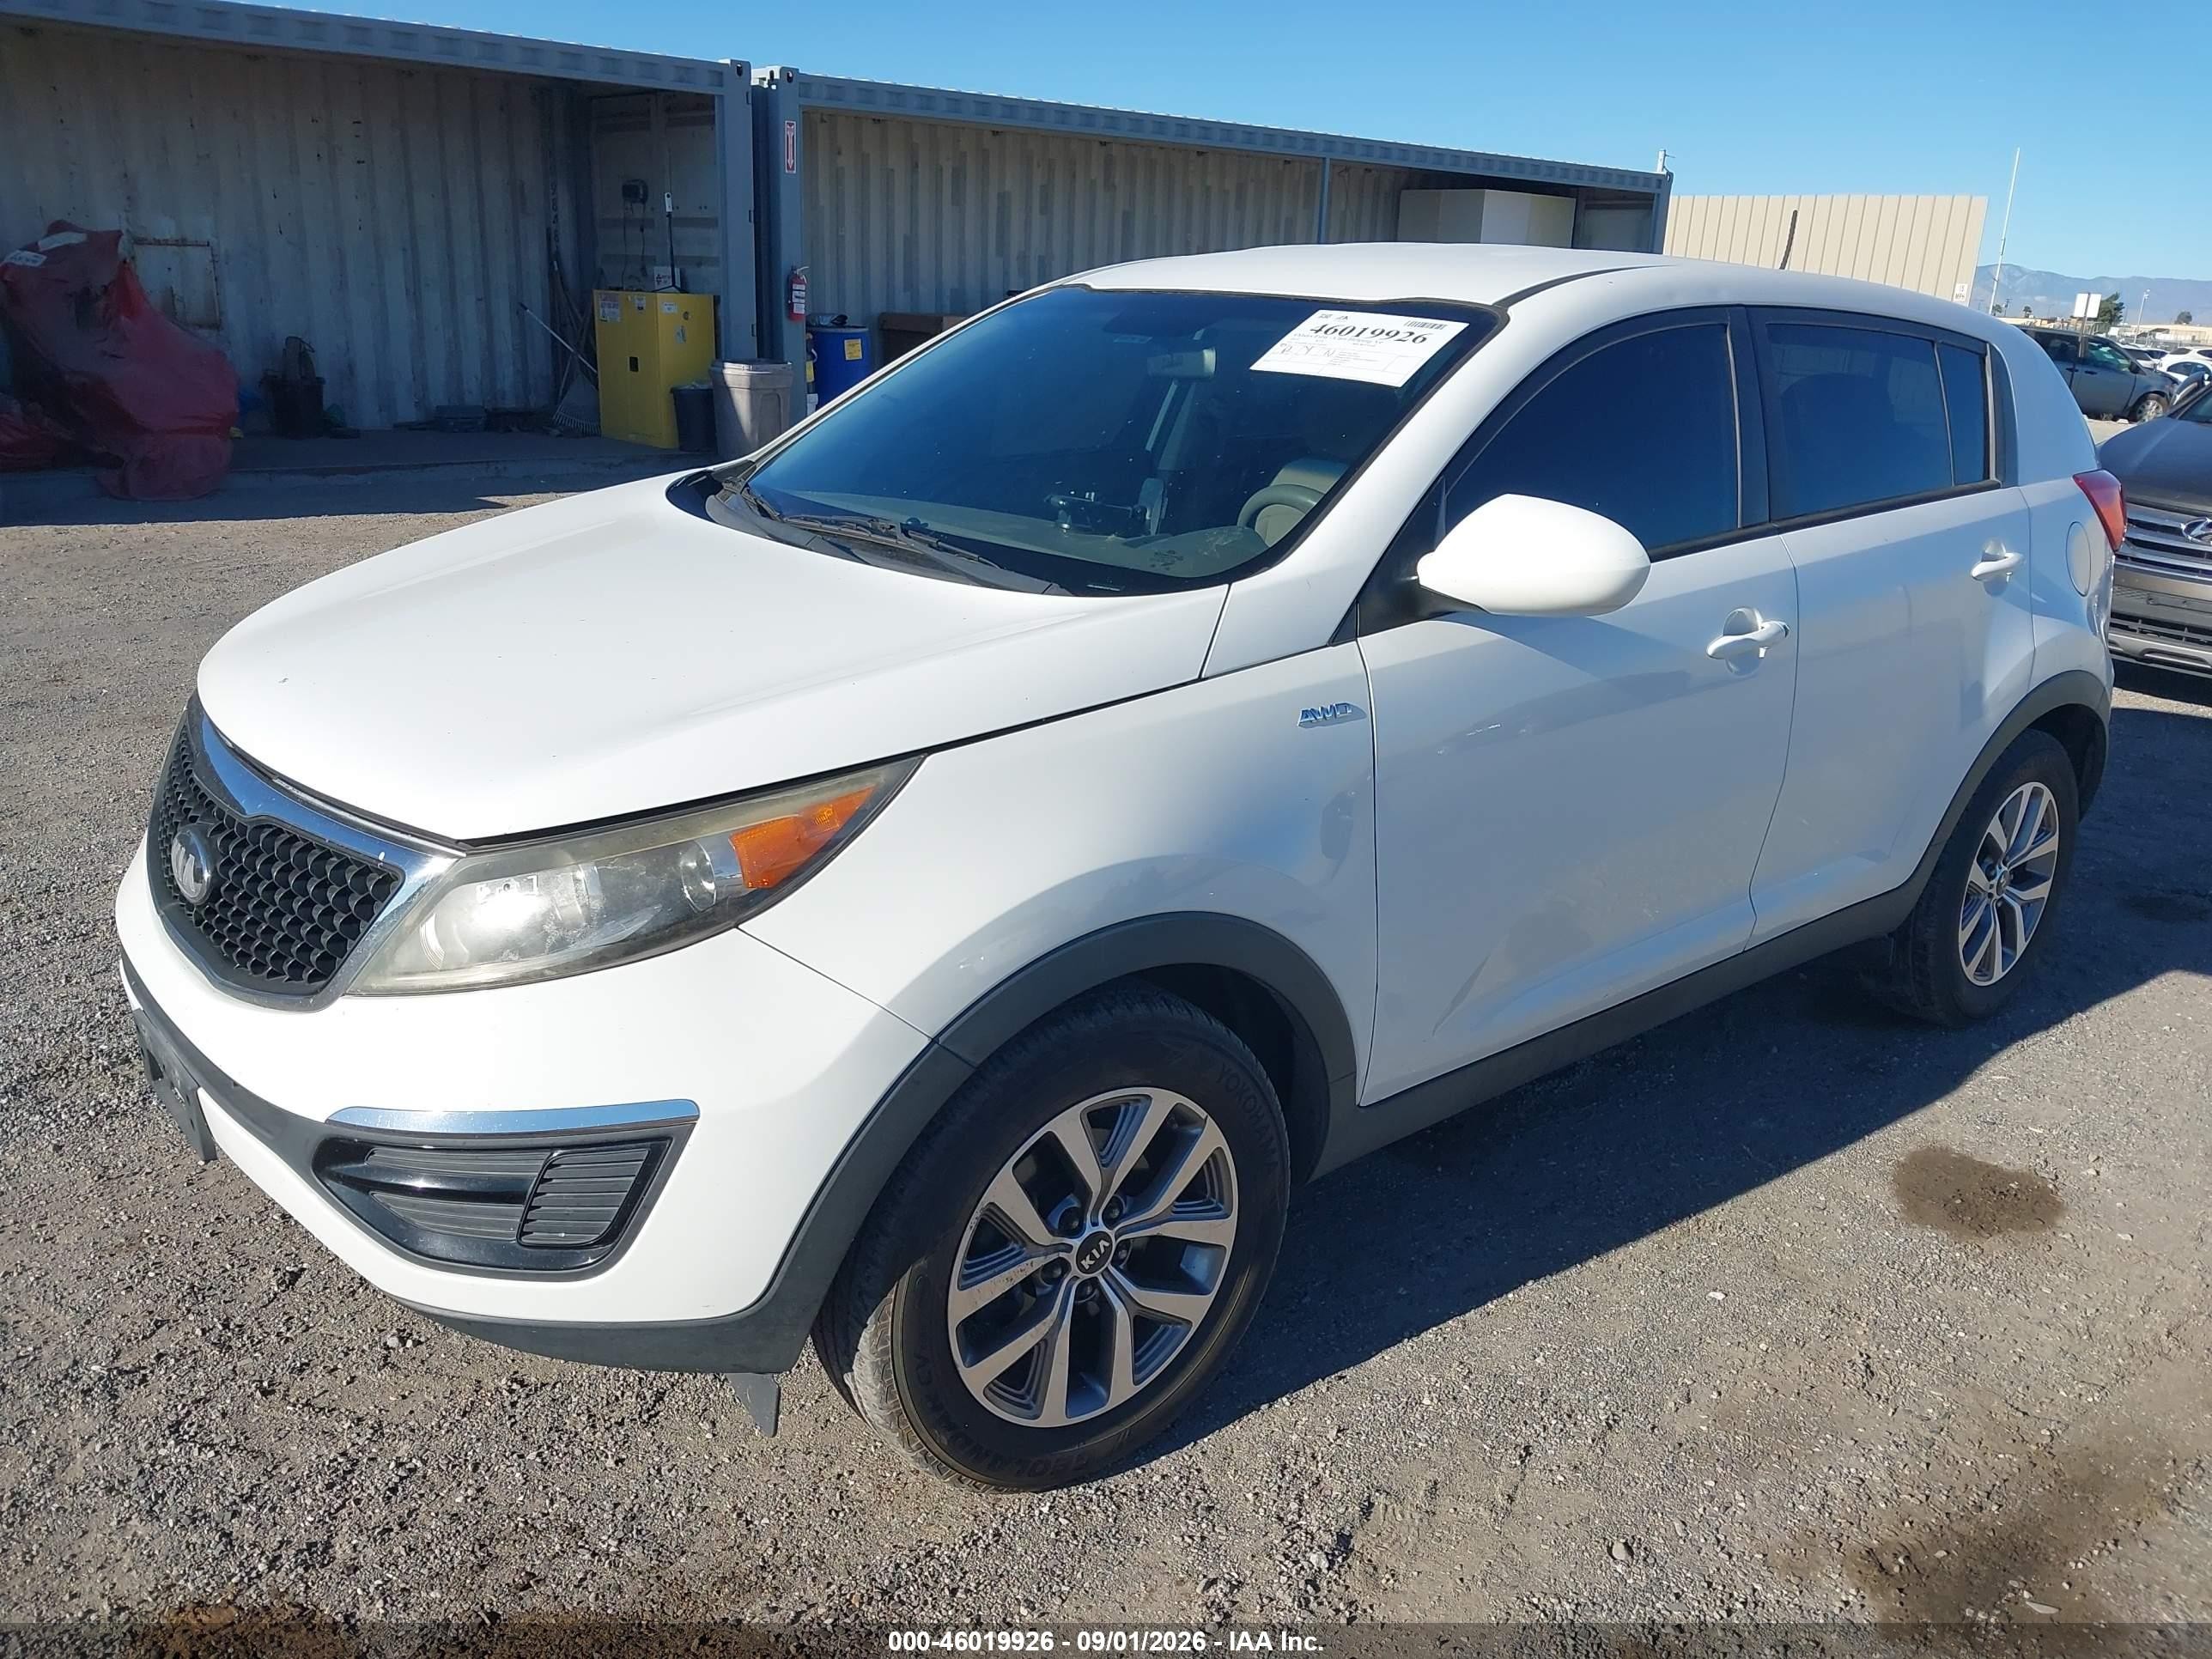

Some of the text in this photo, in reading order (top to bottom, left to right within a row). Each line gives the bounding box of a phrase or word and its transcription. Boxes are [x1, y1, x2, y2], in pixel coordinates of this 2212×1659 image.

[1310, 324, 1433, 344] 46019926
[1298, 702, 1352, 723] AWD
[1080, 1239, 1111, 1270] KIA
